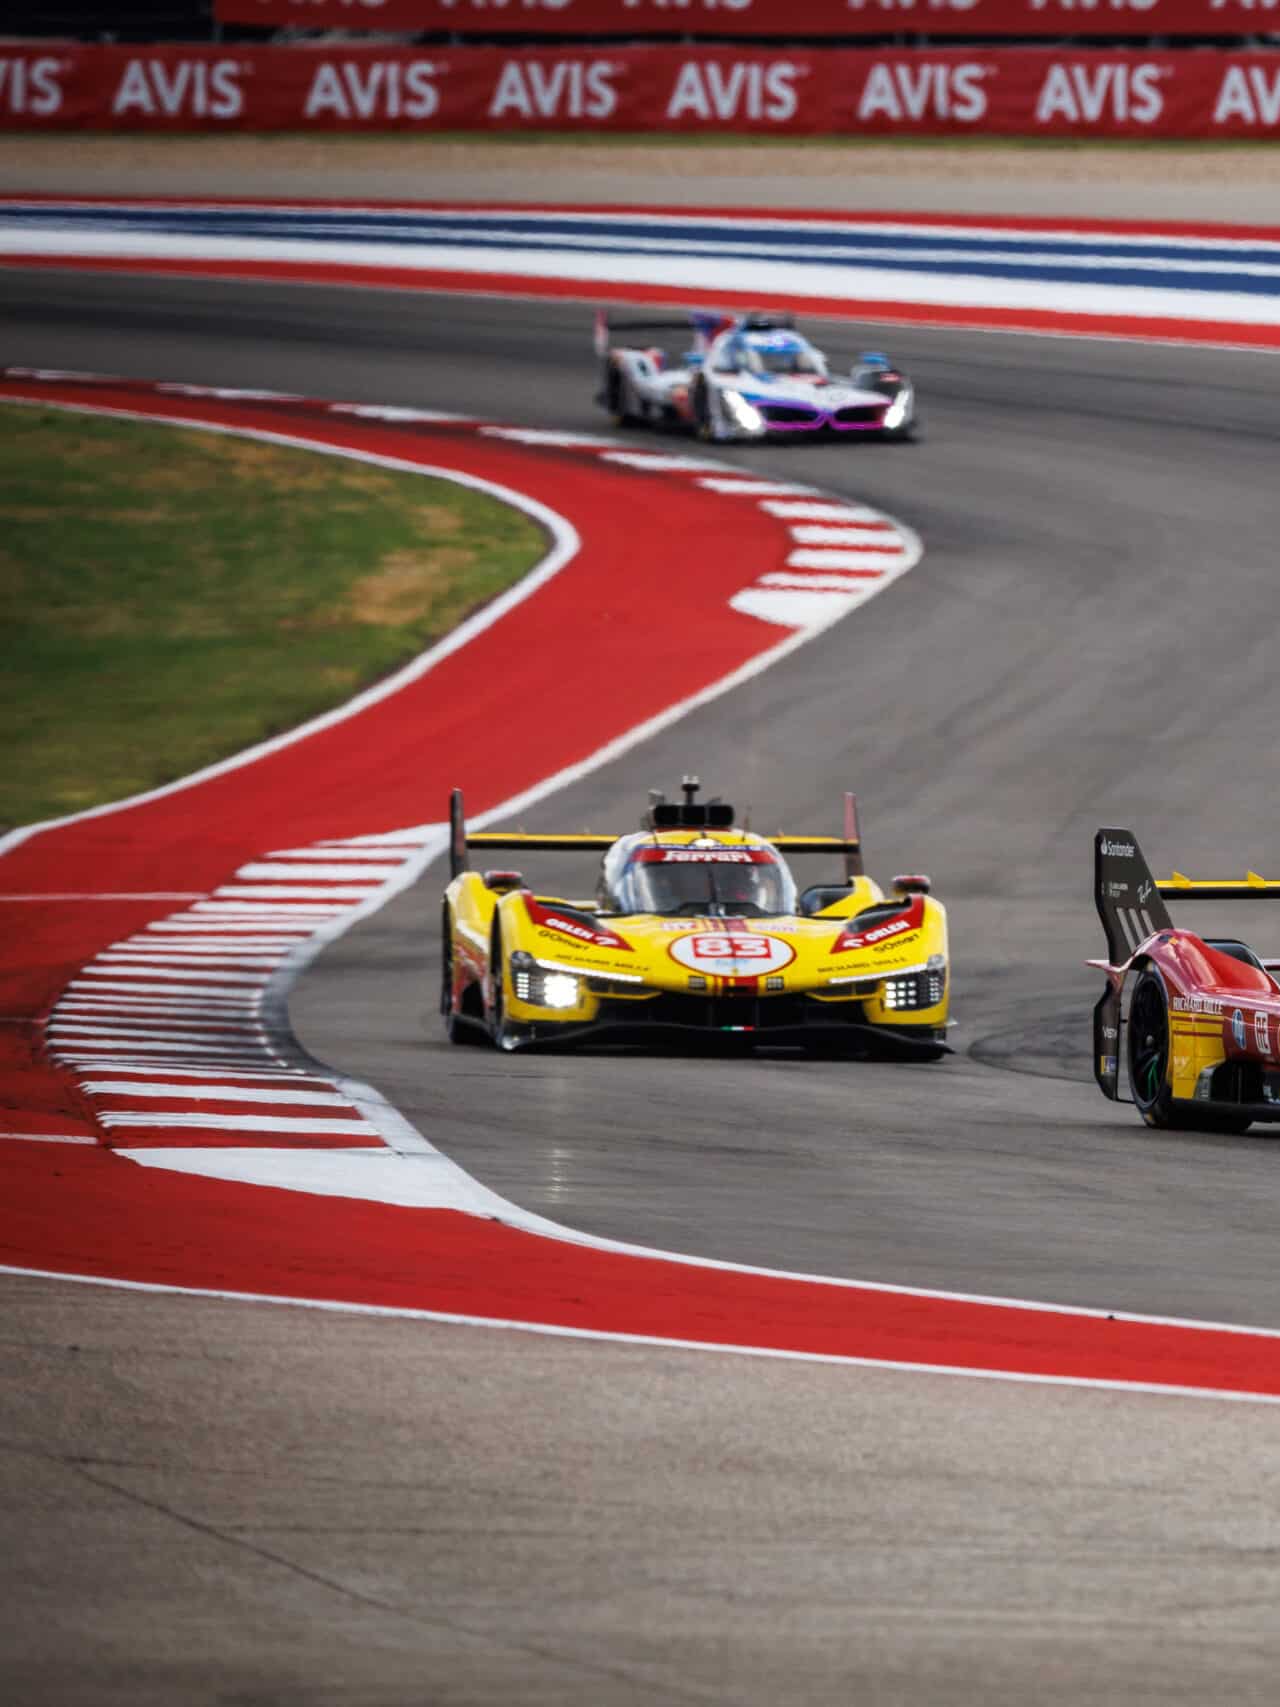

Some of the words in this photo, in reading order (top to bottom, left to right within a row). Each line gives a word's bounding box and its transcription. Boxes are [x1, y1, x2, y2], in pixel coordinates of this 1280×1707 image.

[115, 61, 242, 116] AVIS
[306, 62, 439, 117] AVIS
[490, 62, 617, 118] AVIS
[667, 62, 798, 121] AVIS
[858, 62, 988, 122] AVIS
[1037, 63, 1163, 124] AVIS
[696, 938, 769, 957] 83
